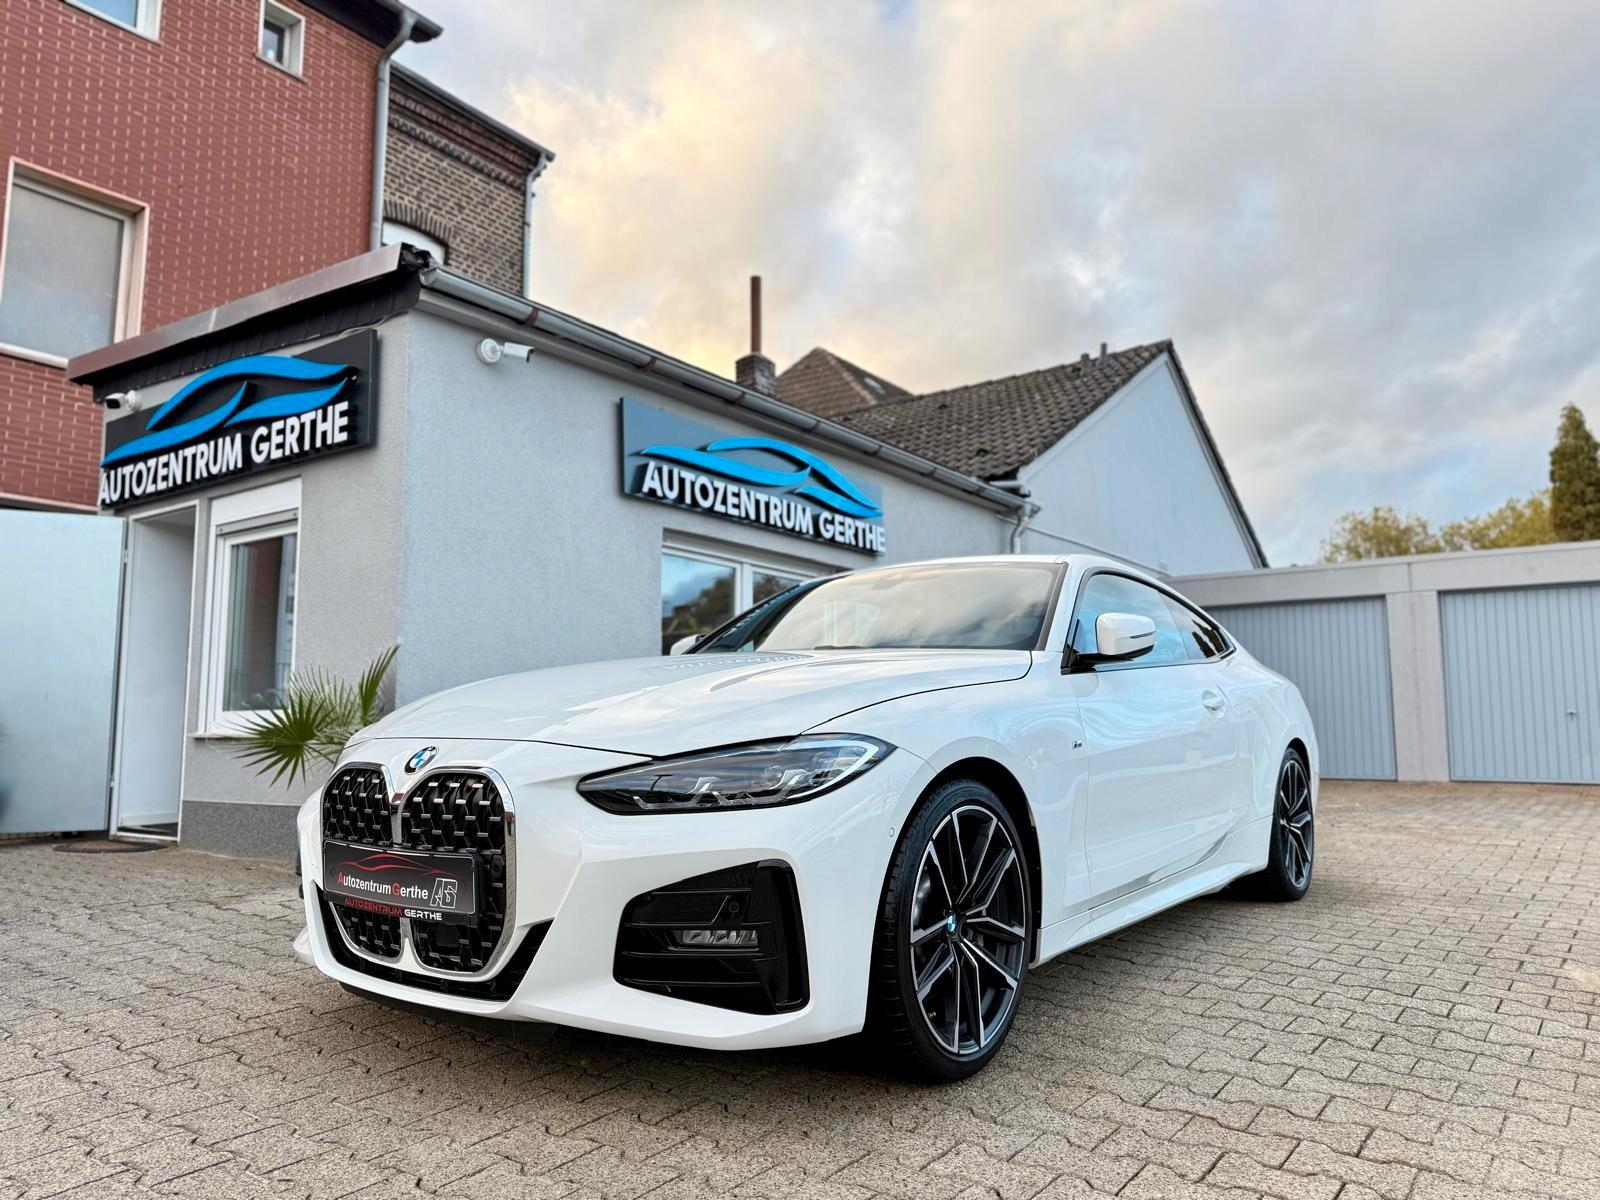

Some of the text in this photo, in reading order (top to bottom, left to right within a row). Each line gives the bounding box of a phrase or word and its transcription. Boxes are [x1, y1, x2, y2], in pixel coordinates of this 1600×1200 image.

[98, 401, 349, 505] AUTOZENTRUM GERTHE
[642, 461, 885, 552] AUTOZENTRUM GERTHE
[338, 872, 428, 899] Autozentrum Gerthe
[345, 898, 442, 920] AUTOZENTRUM GERTHE
